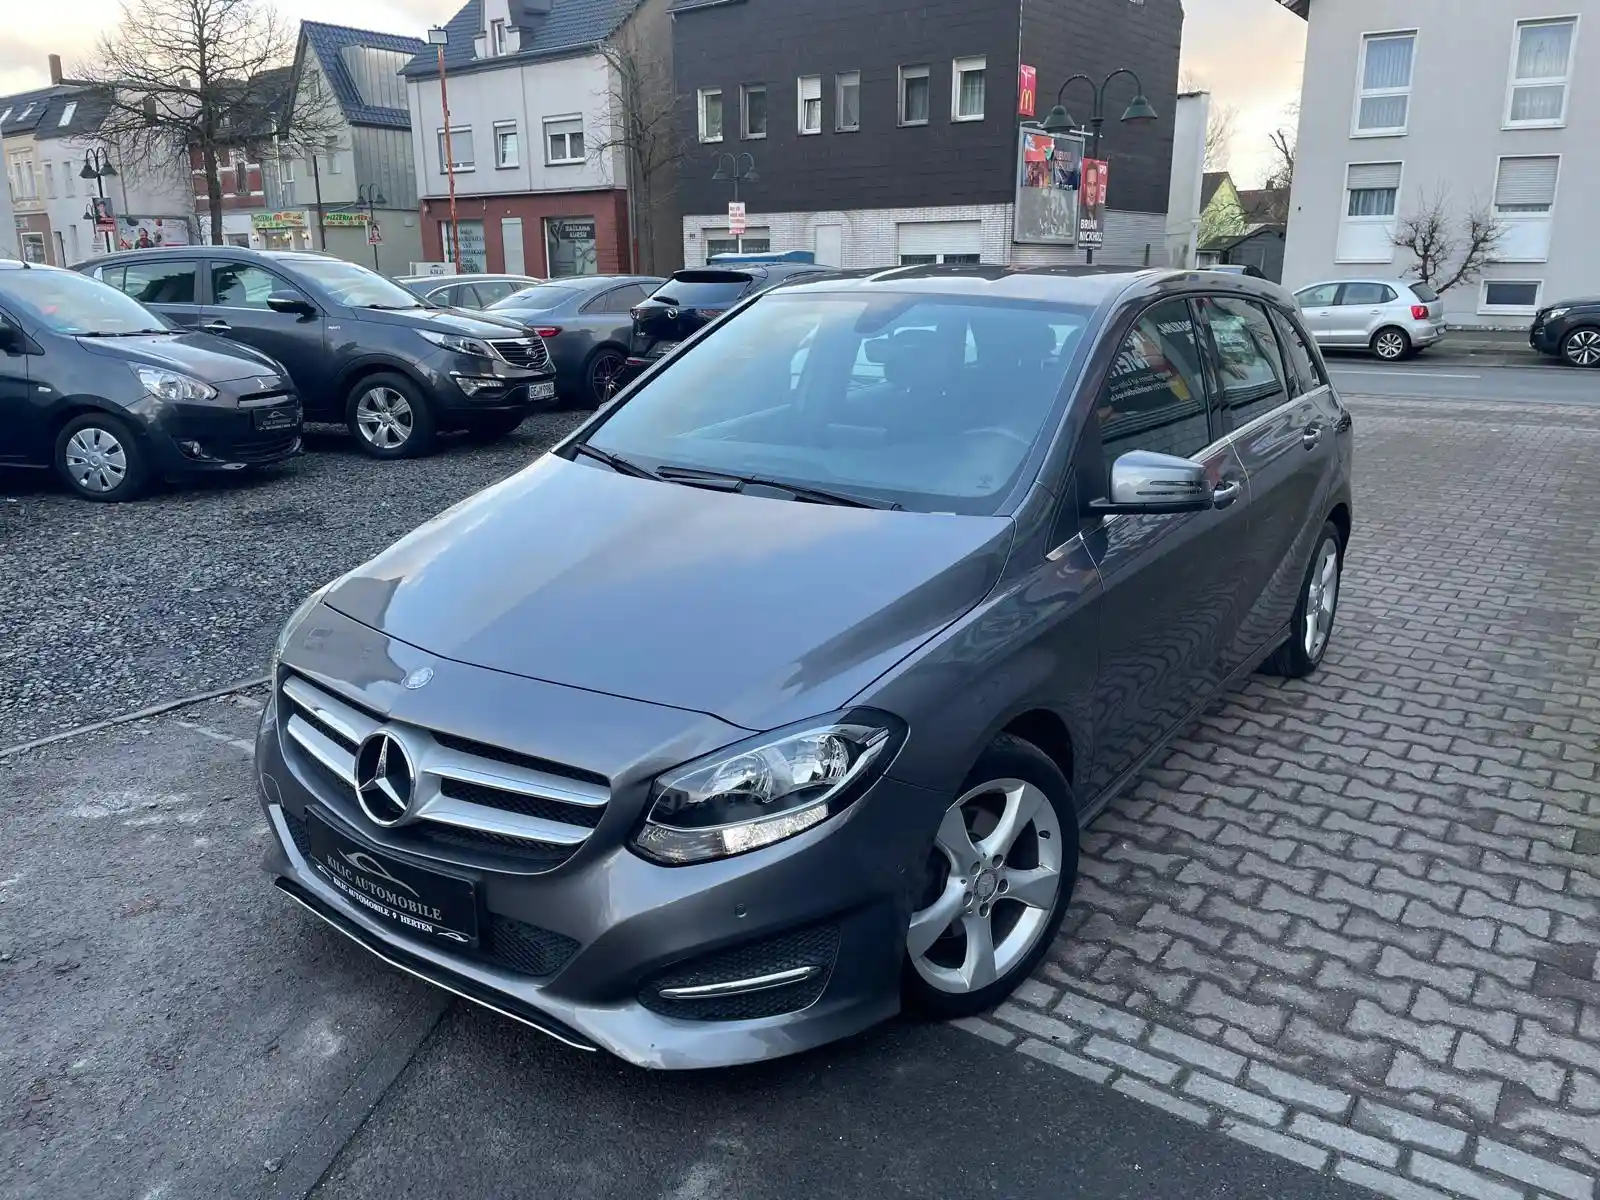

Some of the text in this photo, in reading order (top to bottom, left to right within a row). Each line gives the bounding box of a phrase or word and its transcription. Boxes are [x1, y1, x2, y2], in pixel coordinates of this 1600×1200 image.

[1080, 219, 1098, 230] BRIAN
[327, 855, 442, 921] KILIC AUTOMOBILE
[348, 888, 390, 917] AUTOMOBILE
[400, 914, 433, 933] HERTEN
